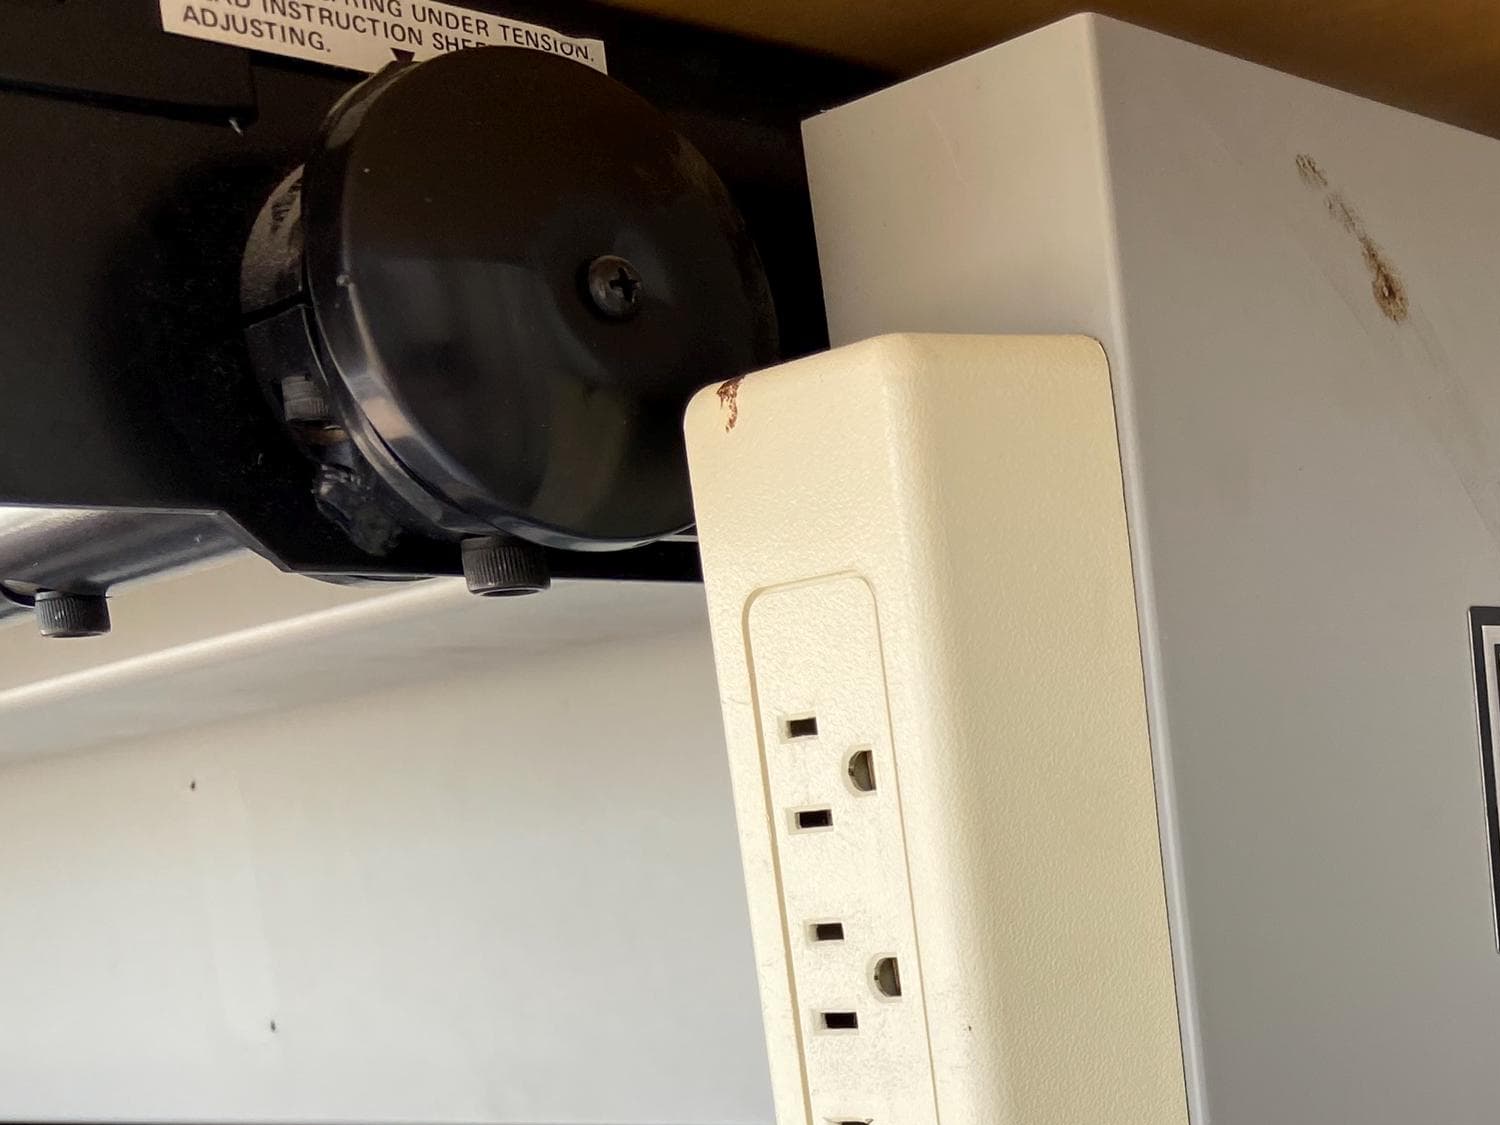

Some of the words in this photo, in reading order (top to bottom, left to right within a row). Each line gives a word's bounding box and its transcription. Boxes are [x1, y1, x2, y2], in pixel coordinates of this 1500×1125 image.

[182, 5, 332, 53] ADJUSTING.
[262, 0, 423, 46] INSTRUCTION
[411, 4, 490, 37] UNDER
[498, 24, 595, 62] TENSION.
